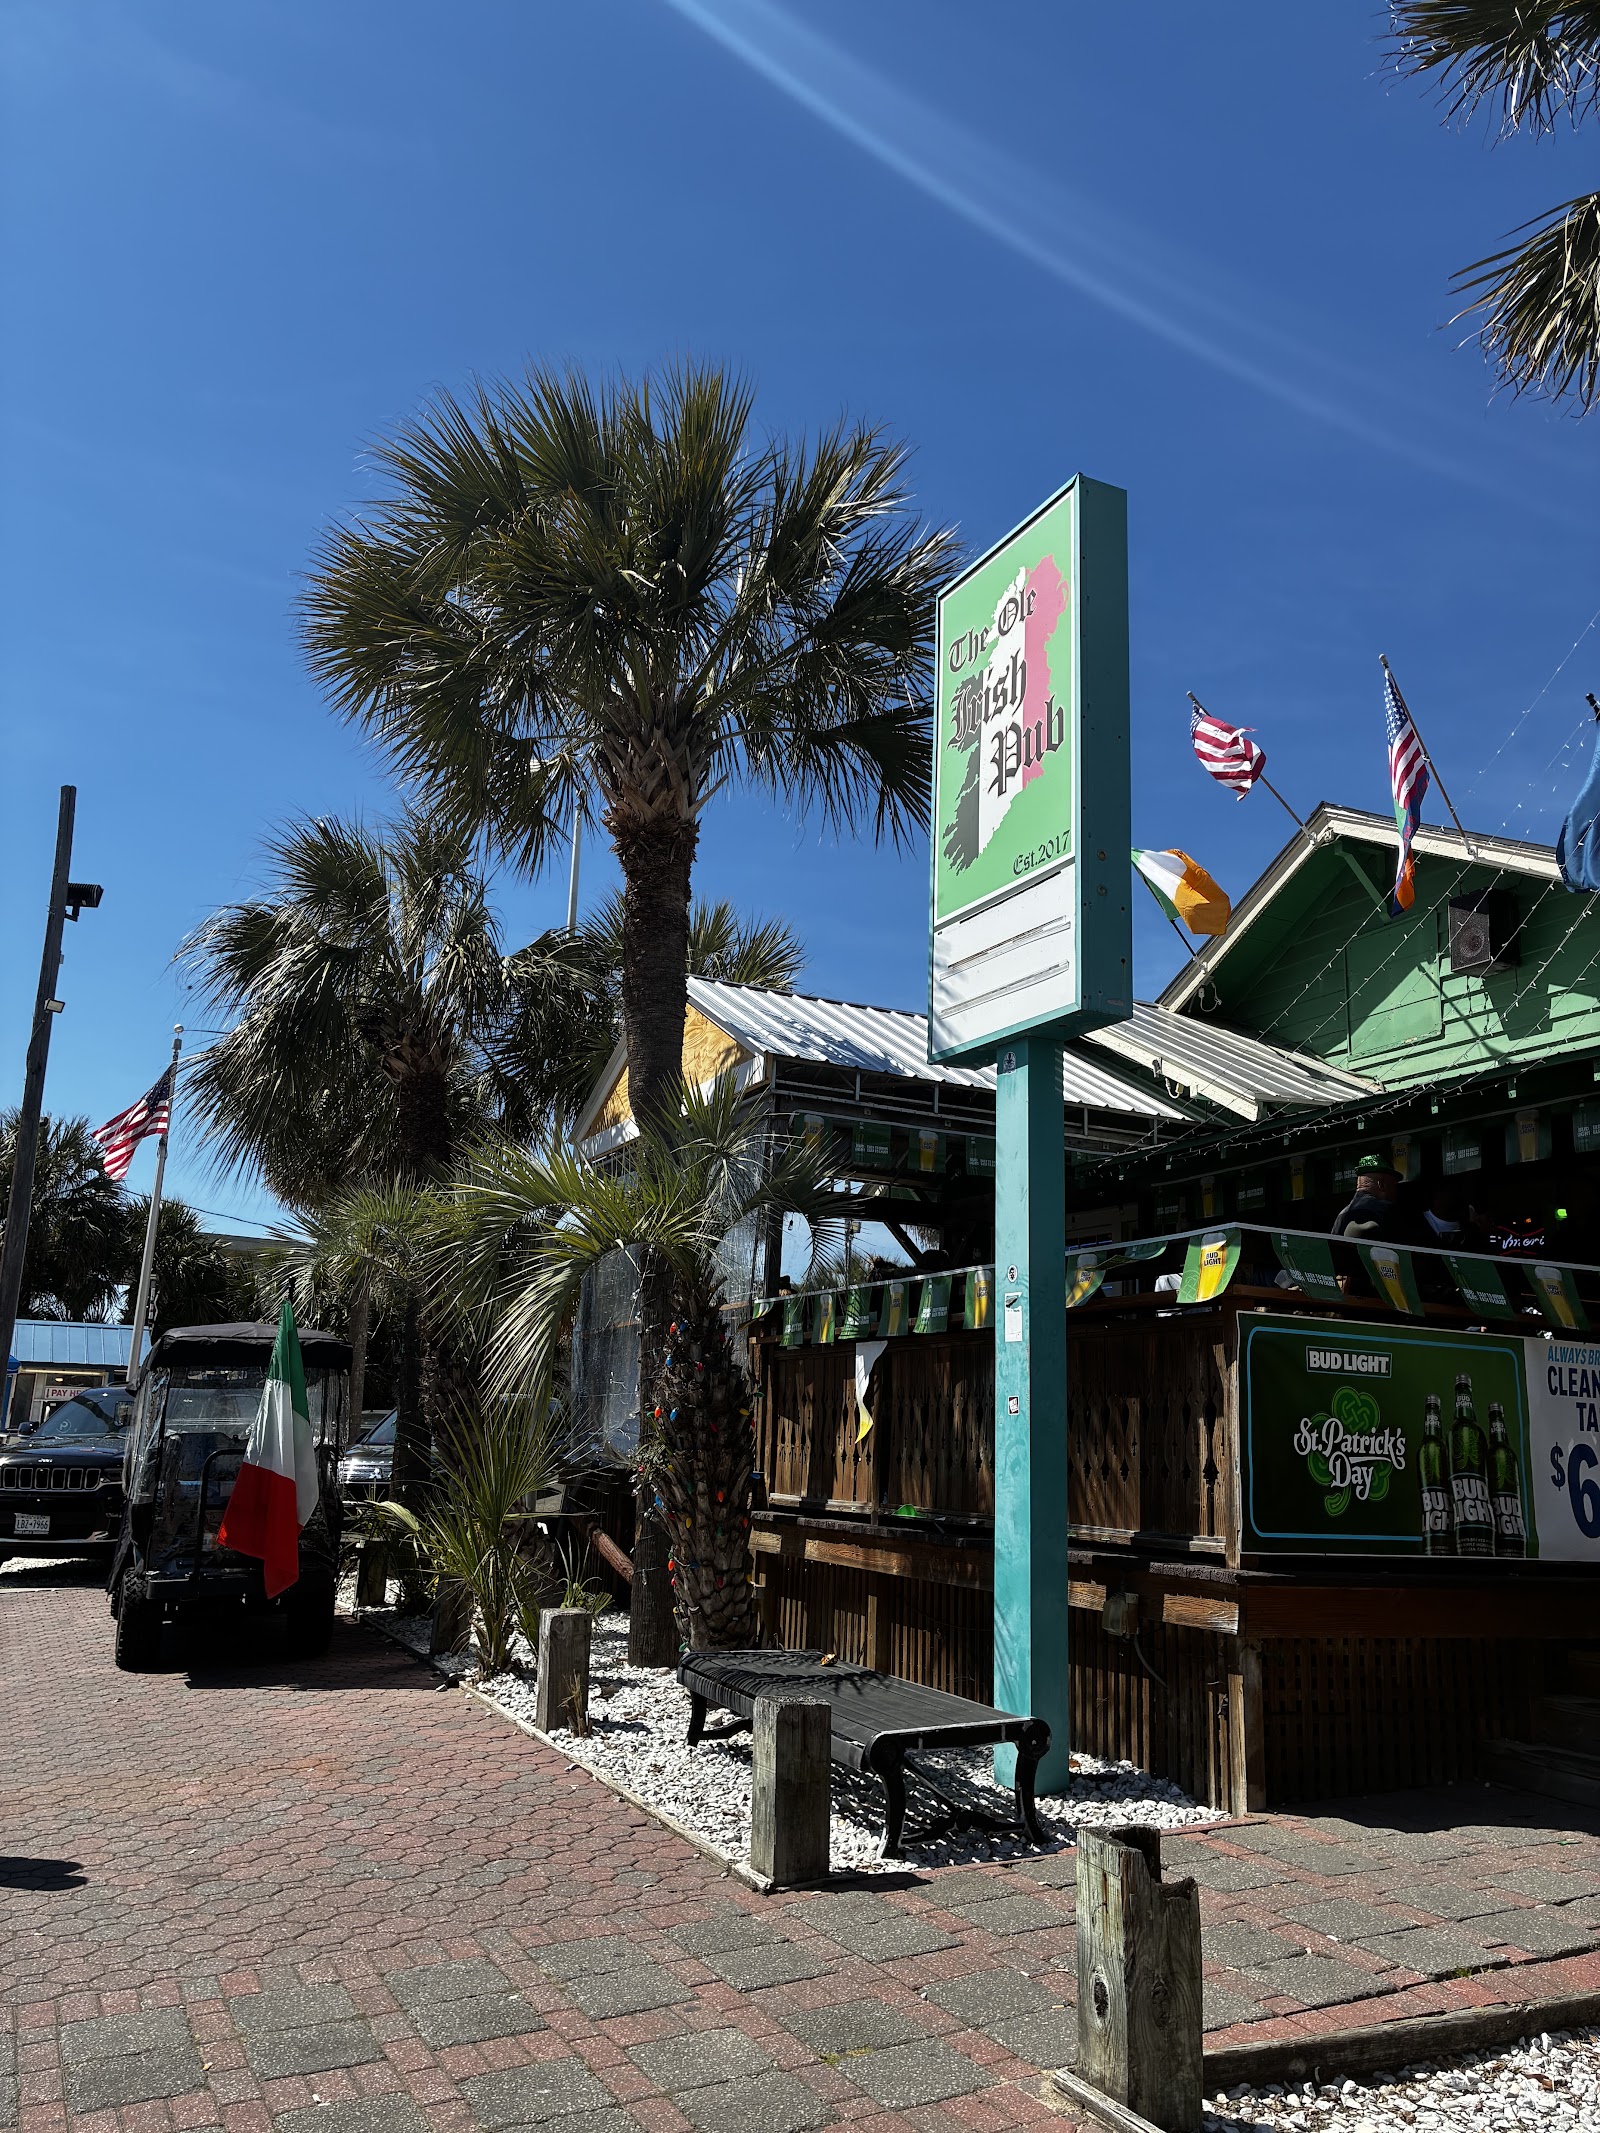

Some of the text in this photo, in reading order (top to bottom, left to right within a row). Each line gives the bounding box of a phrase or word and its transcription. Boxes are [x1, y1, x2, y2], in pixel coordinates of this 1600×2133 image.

[948, 587, 1037, 673] The Ole
[945, 648, 1028, 752] Irish
[987, 694, 1065, 798] Pub
[1203, 1257, 1222, 1266] LIGHT
[1206, 1251, 1218, 1259] BUD
[1308, 1350, 1390, 1374] BUD LIGHT
[1547, 1345, 1587, 1365] ALWAYS
[51, 1389, 68, 1397] PAY
[1547, 1365, 1600, 1399] CLEAN
[1293, 1417, 1406, 1471] St. Patrick's
[1328, 1451, 1374, 1501] Day
[1452, 1478, 1489, 1501] BUD
